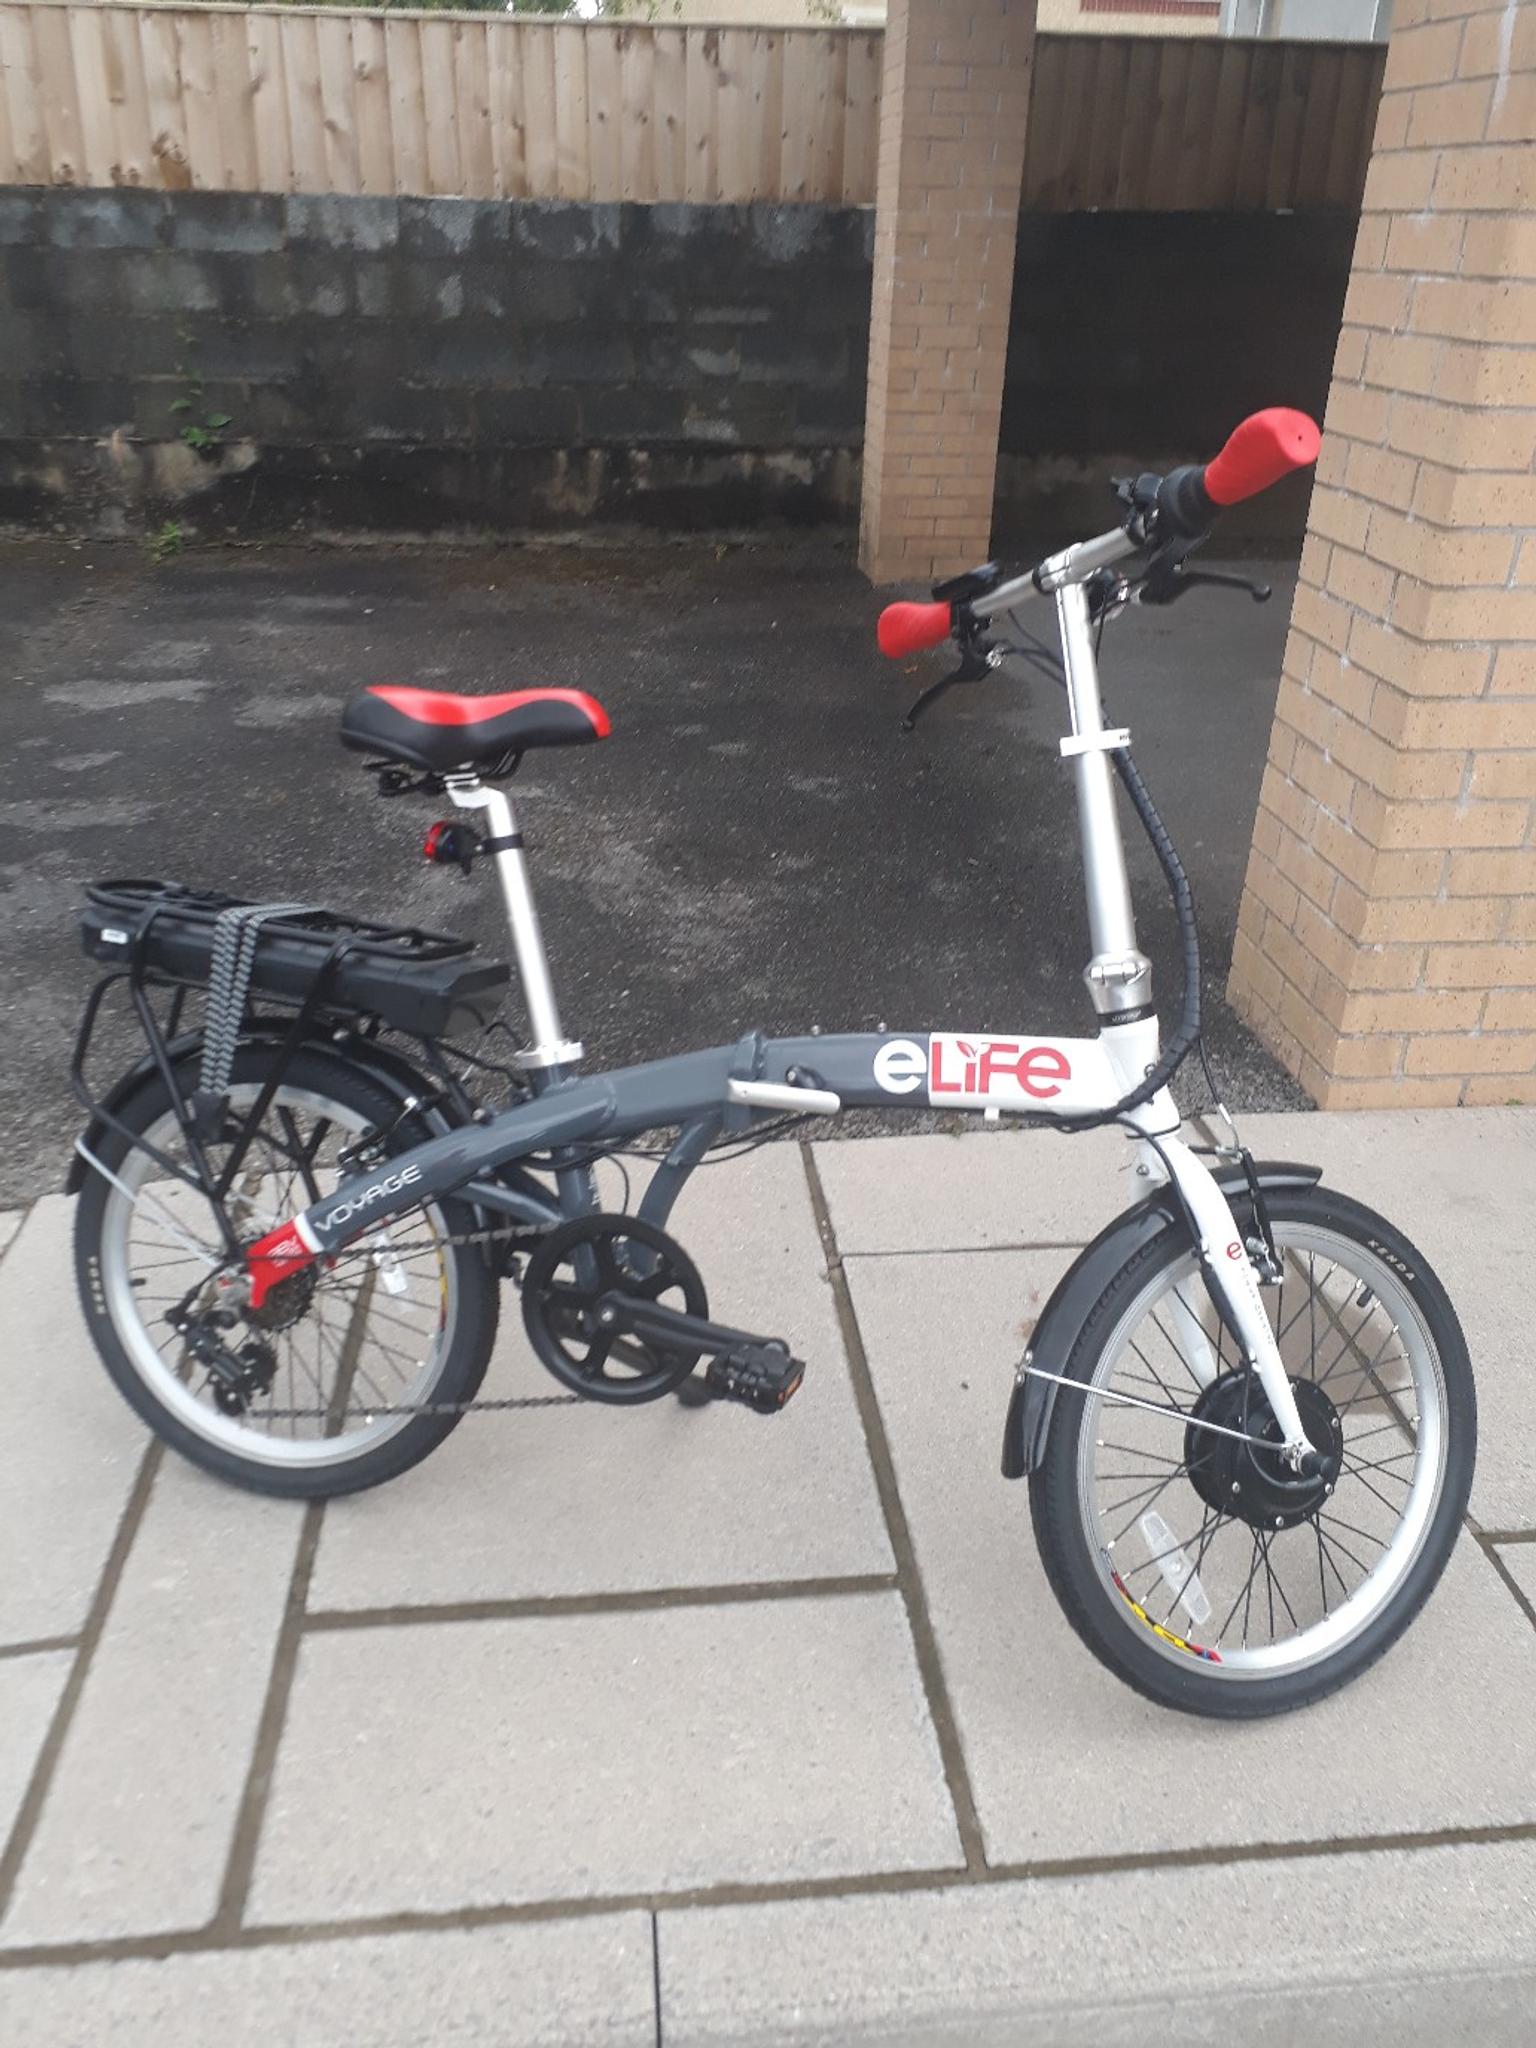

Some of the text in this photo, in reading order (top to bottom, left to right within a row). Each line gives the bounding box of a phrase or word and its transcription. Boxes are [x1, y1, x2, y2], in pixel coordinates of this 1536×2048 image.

[314, 1164, 422, 1231] VOYAGE
[1227, 1242, 1242, 1260] e
[1367, 1240, 1415, 1280] KENDA
